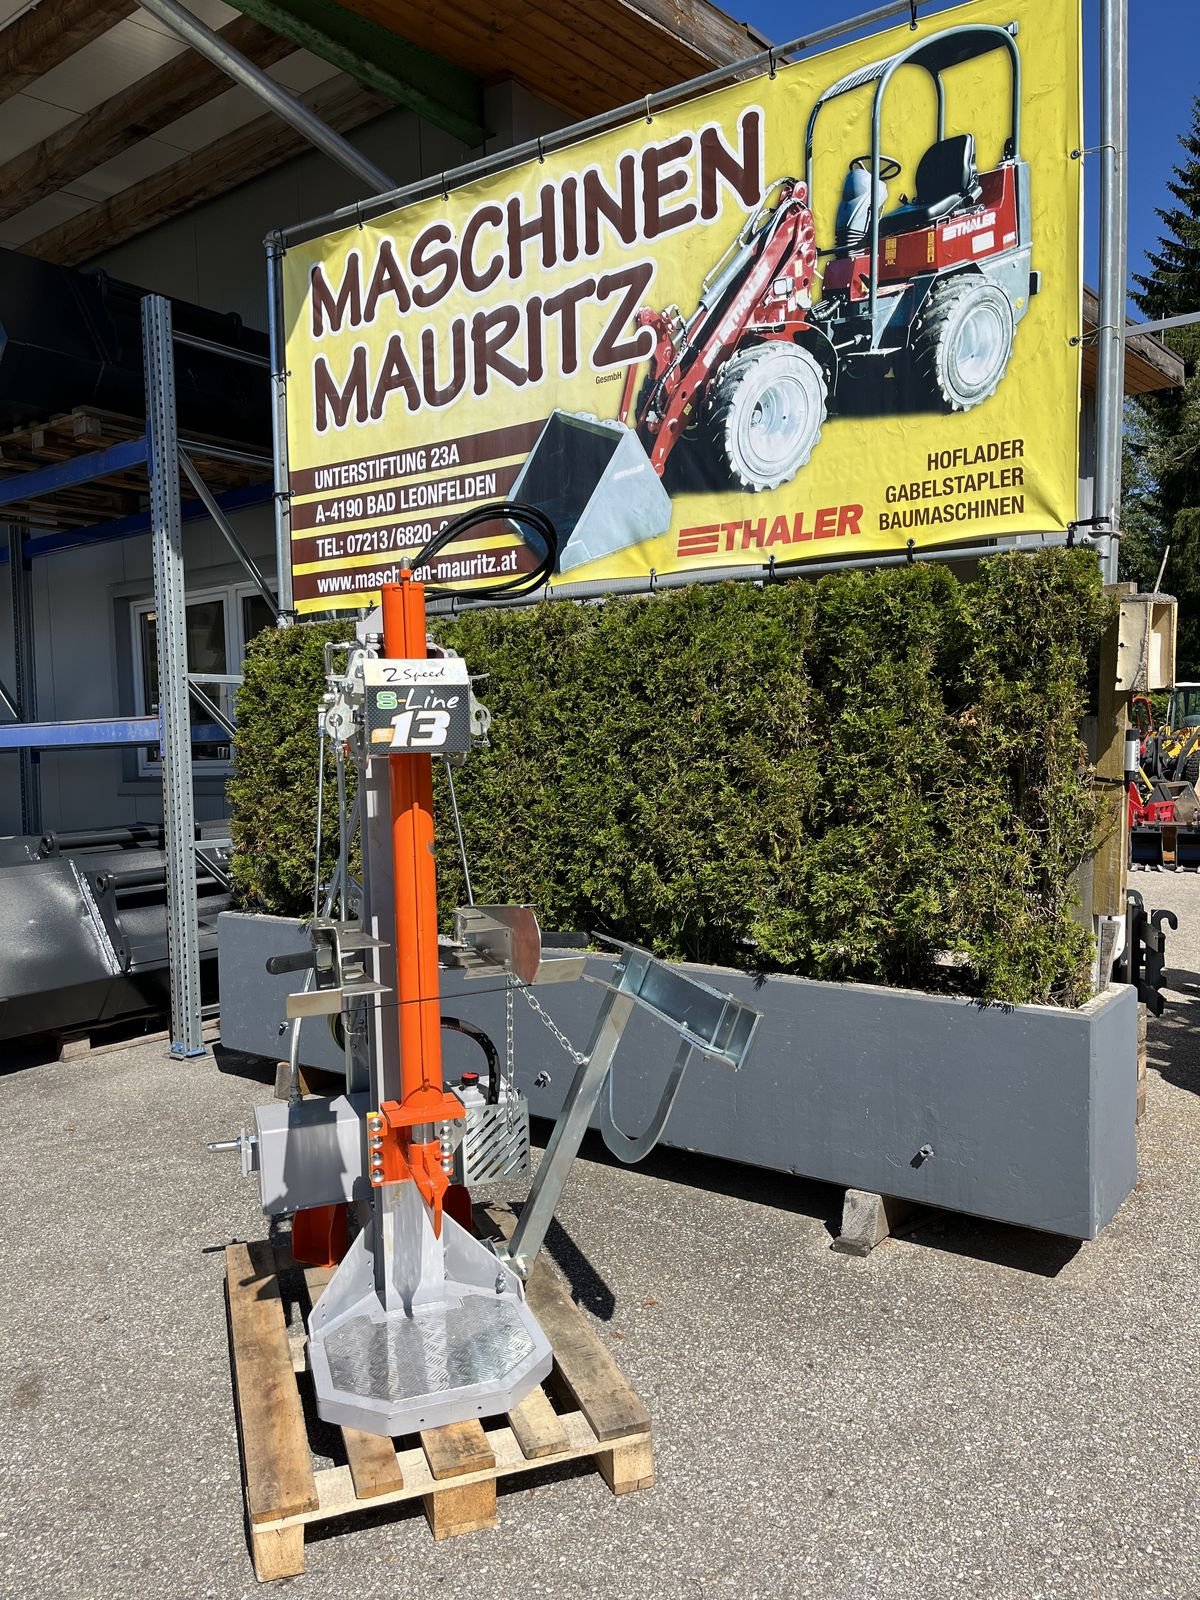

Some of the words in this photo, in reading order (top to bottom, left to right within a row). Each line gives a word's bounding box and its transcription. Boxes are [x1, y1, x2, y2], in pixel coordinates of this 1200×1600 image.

[312, 111, 762, 337] MASCHINEN
[954, 211, 997, 238] THALER
[314, 262, 655, 432] MAURITZ
[595, 371, 622, 385] GesmbH
[314, 450, 427, 490] UNTERSTIFTUNG
[430, 443, 460, 468] 23A
[927, 438, 1025, 472] HOFLADER
[315, 499, 364, 524] A-4190
[366, 490, 397, 514] BAD
[400, 473, 497, 509] LEONFELDEN
[885, 466, 1024, 504] GABELSTAPLER
[720, 503, 864, 550] THALER
[878, 494, 1025, 531] BAUMASCHINEN
[315, 533, 344, 558] TEL:
[317, 550, 518, 594] www.maschen-mauritz.at
[403, 667, 446, 682] Speed
[376, 688, 460, 709] S-Line
[389, 711, 451, 747] 13
